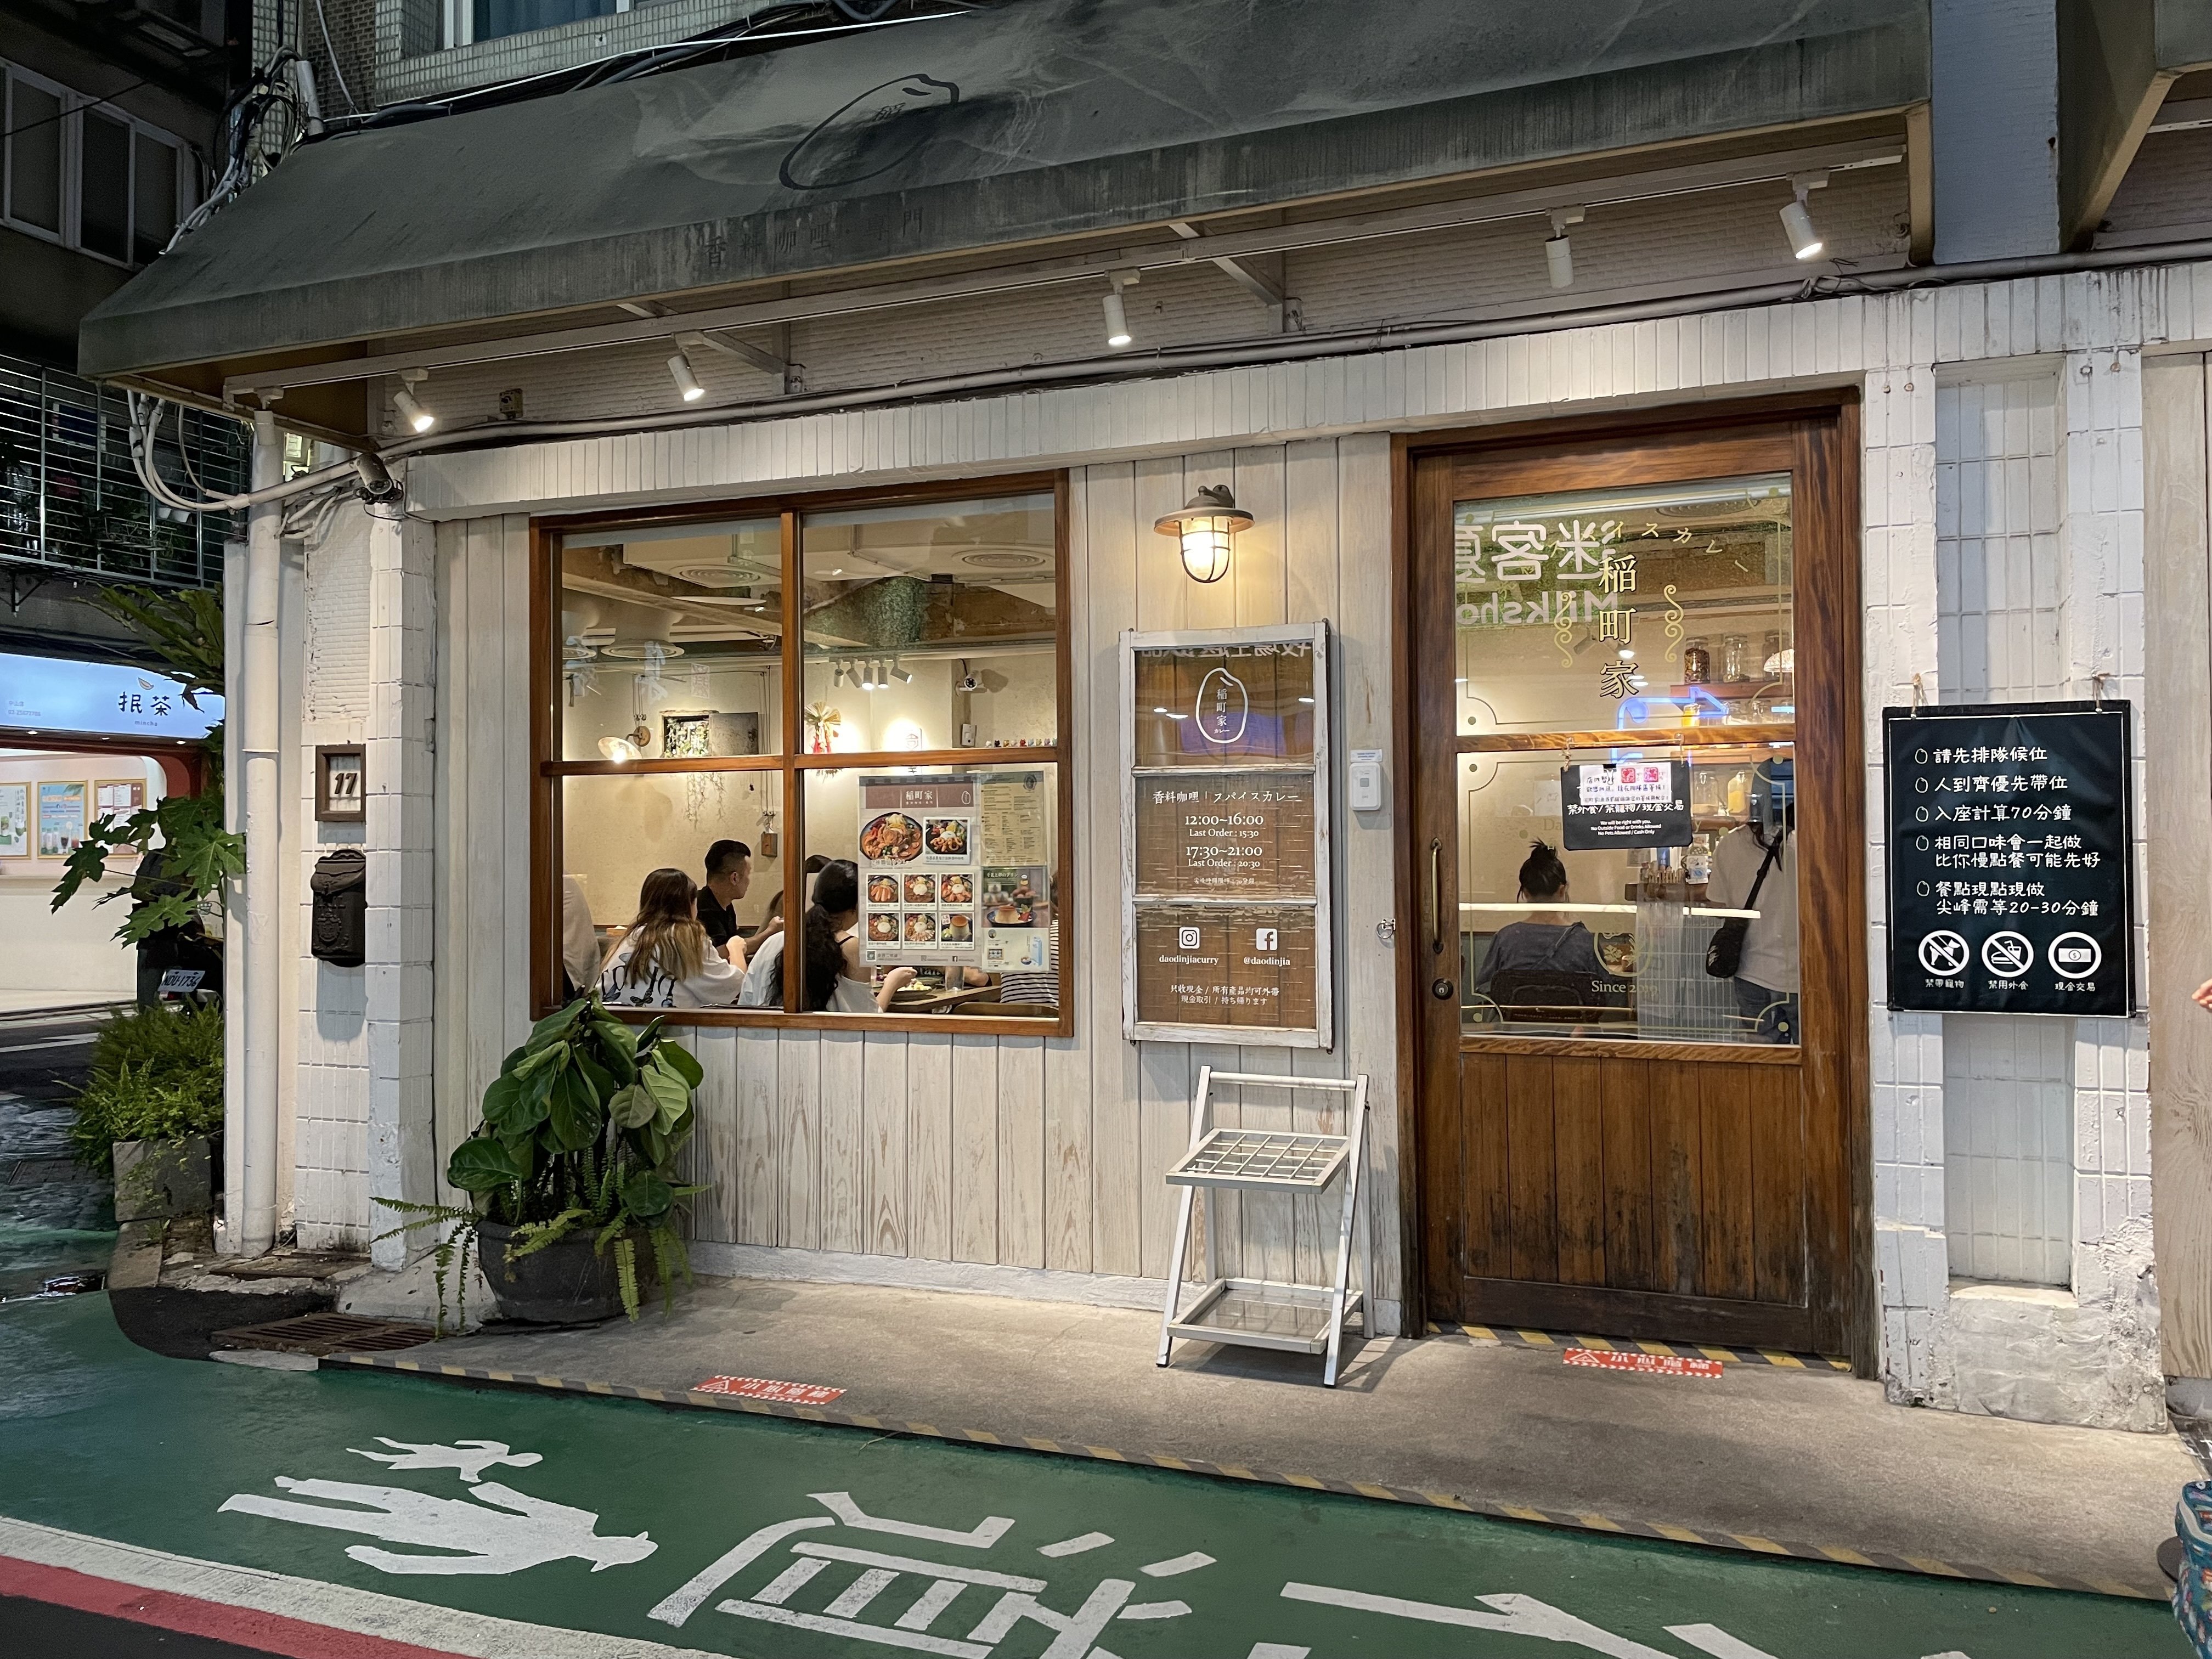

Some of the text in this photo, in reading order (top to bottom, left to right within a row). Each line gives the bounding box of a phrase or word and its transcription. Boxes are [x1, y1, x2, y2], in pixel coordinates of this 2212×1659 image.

[118, 691, 172, 716] 抿茶
[1933, 747, 2047, 764] 請先排隊候位
[334, 772, 358, 794] 17
[1934, 774, 2068, 793] 人到齊優先帶位
[1152, 791, 1200, 804] 香料咖哩
[1184, 812, 1263, 825] 12:00~16:00
[1935, 804, 2072, 822] 入座計算70分鐘
[1239, 830, 1259, 838] 15:30
[1934, 833, 2082, 851] 相同口味會一起做
[1186, 846, 1263, 859] 17:30~21:00
[1238, 861, 1260, 869] 20:30
[1936, 851, 2101, 870] 比你慢點餐可能先好
[1936, 881, 2045, 898] 餐點現點現做
[1937, 899, 2099, 917] 尖峰需等20-30分鐘
[1159, 955, 1290, 967] daodinjiacurry @daodinjia
[1170, 985, 1203, 994] 只收現金
[1212, 986, 1279, 996] 所有產品均可外帶
[1592, 980, 1626, 992] Since
[1925, 978, 2096, 992] 禁帶寵物 禁用外食 現金交易
[1181, 995, 1211, 1004] 現金取引
